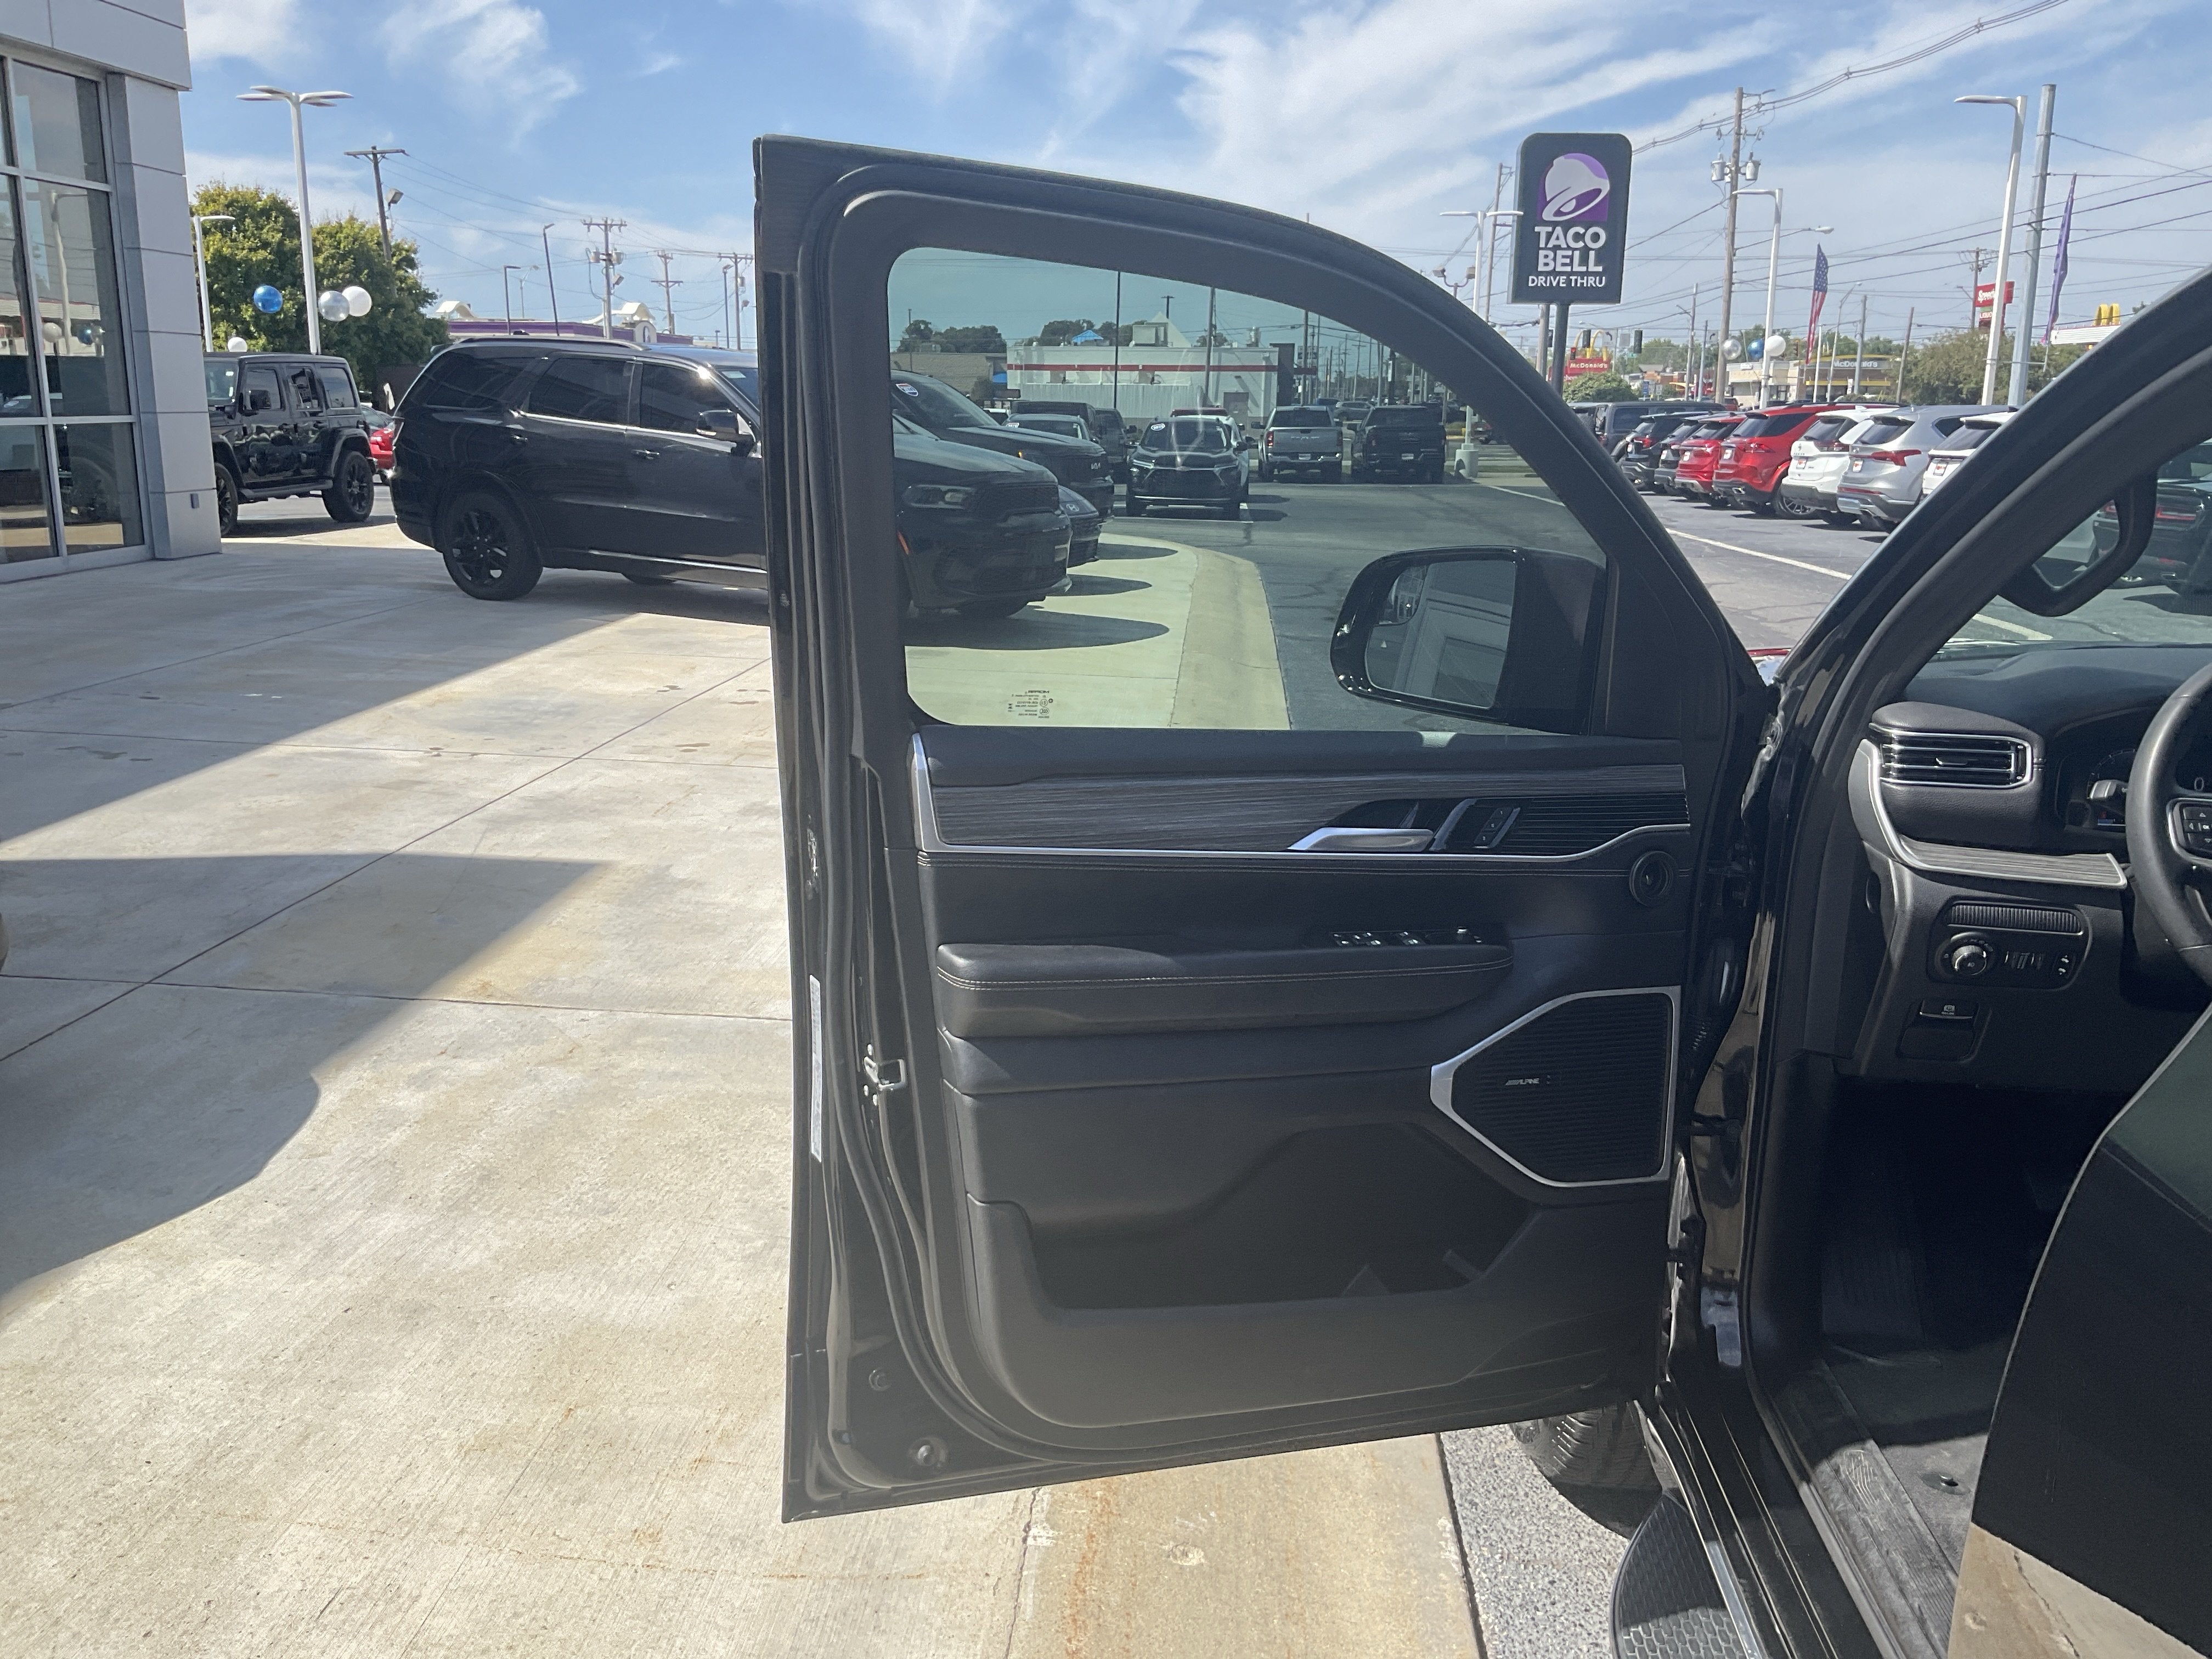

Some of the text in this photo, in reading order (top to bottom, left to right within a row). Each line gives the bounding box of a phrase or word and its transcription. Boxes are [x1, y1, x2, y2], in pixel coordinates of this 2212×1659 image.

[1534, 226, 1606, 249] TACO
[1538, 250, 1602, 272] BELL
[1528, 275, 1606, 287] DRIVE THRU
